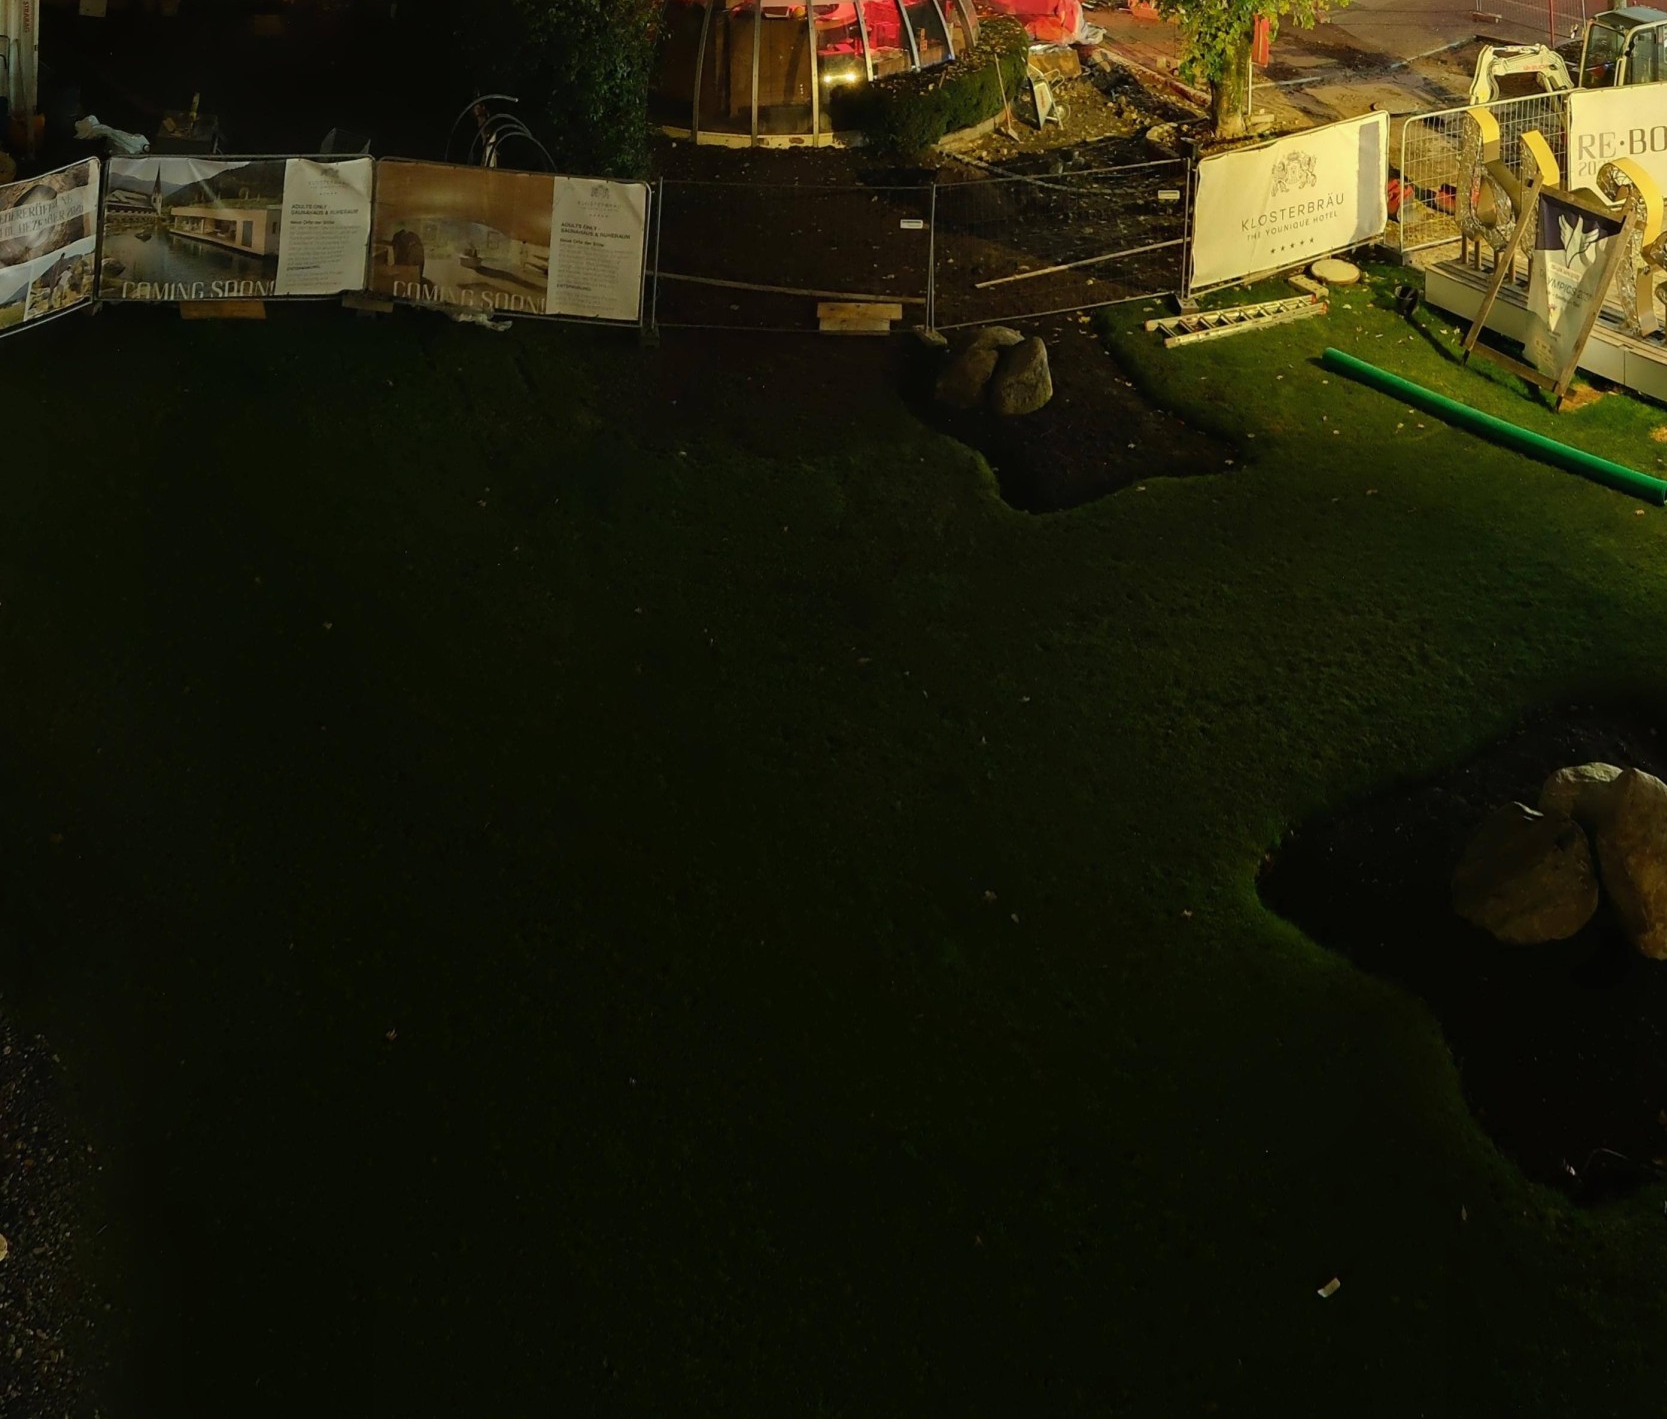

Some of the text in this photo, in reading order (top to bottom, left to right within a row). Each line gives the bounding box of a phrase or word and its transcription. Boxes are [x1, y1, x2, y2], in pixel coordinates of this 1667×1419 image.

[1240, 192, 1345, 232] KLOSTERBRÄU
[1265, 218, 1310, 236] YOUNIQUE
[1313, 210, 1338, 224] HOTEL
[122, 279, 276, 300] COMING SOON!
[392, 280, 547, 316] COMING SOON!
